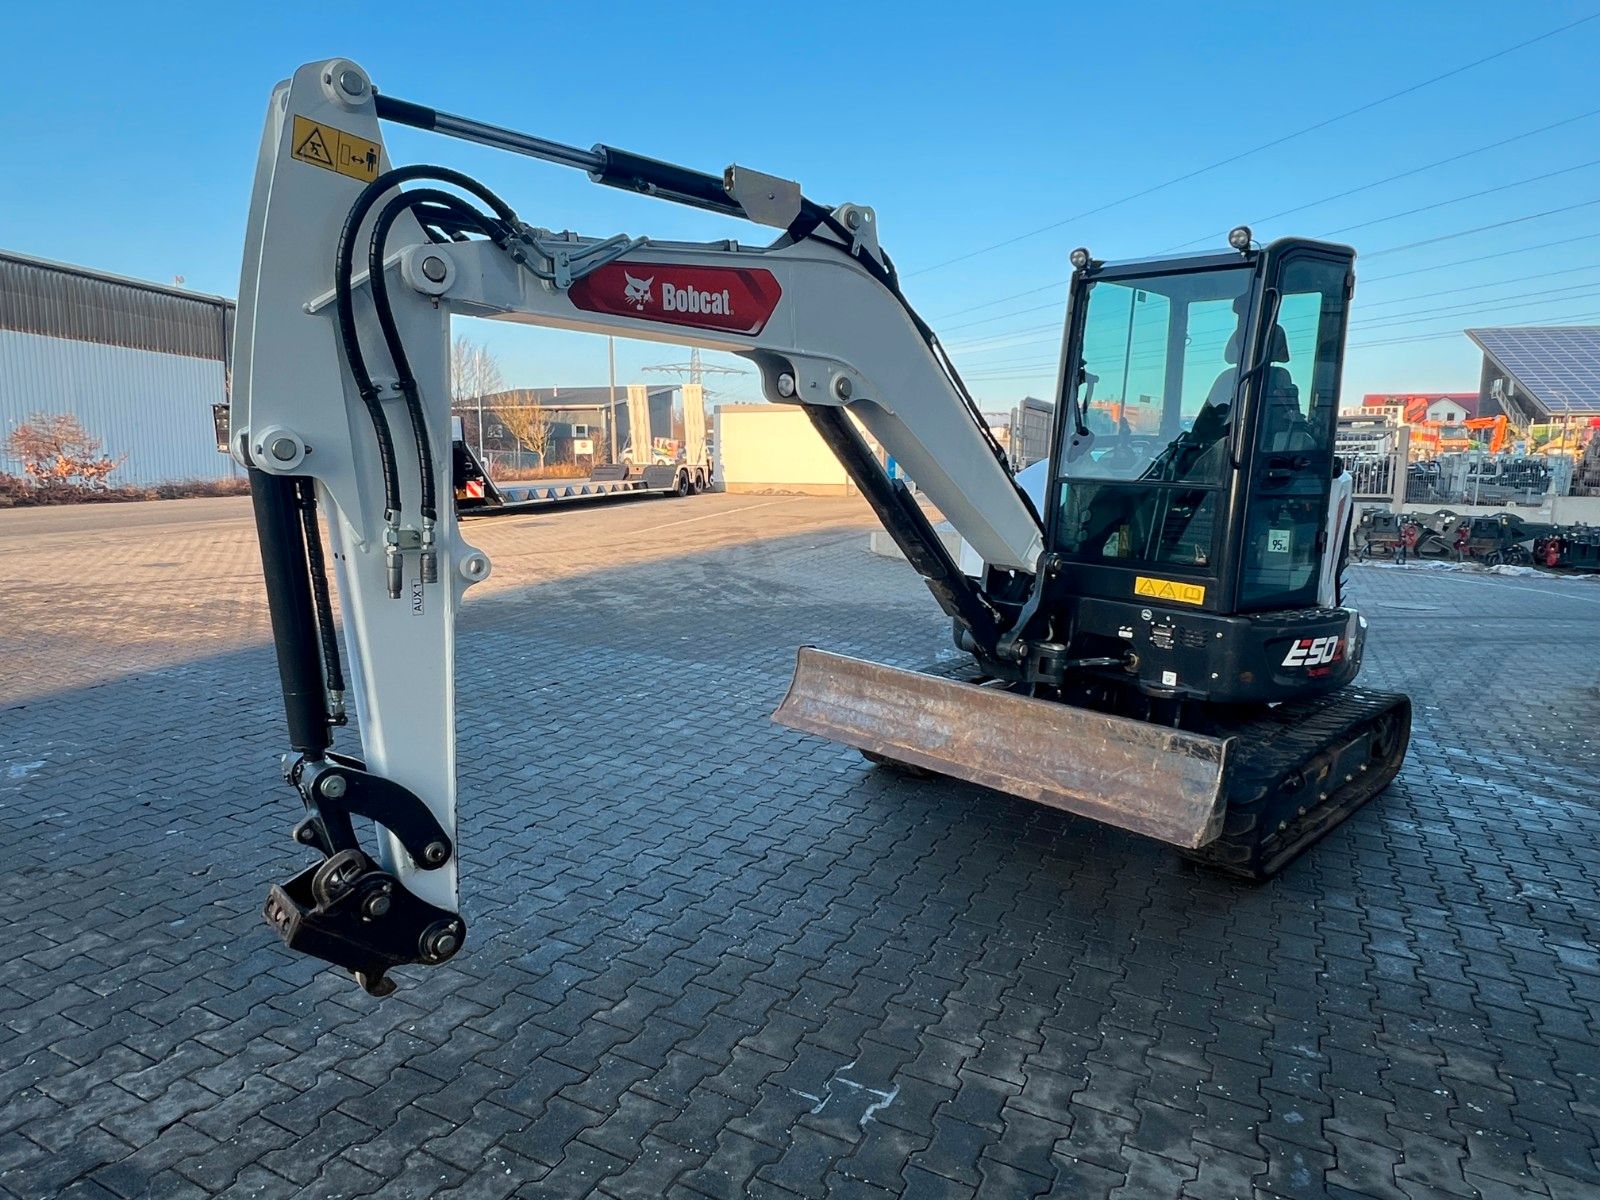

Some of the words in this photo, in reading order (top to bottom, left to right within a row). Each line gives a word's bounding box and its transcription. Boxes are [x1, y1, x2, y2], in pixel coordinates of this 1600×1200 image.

[662, 283, 730, 315] Bobcat
[1272, 539, 1283, 551] 95
[413, 591, 422, 612] AUX
